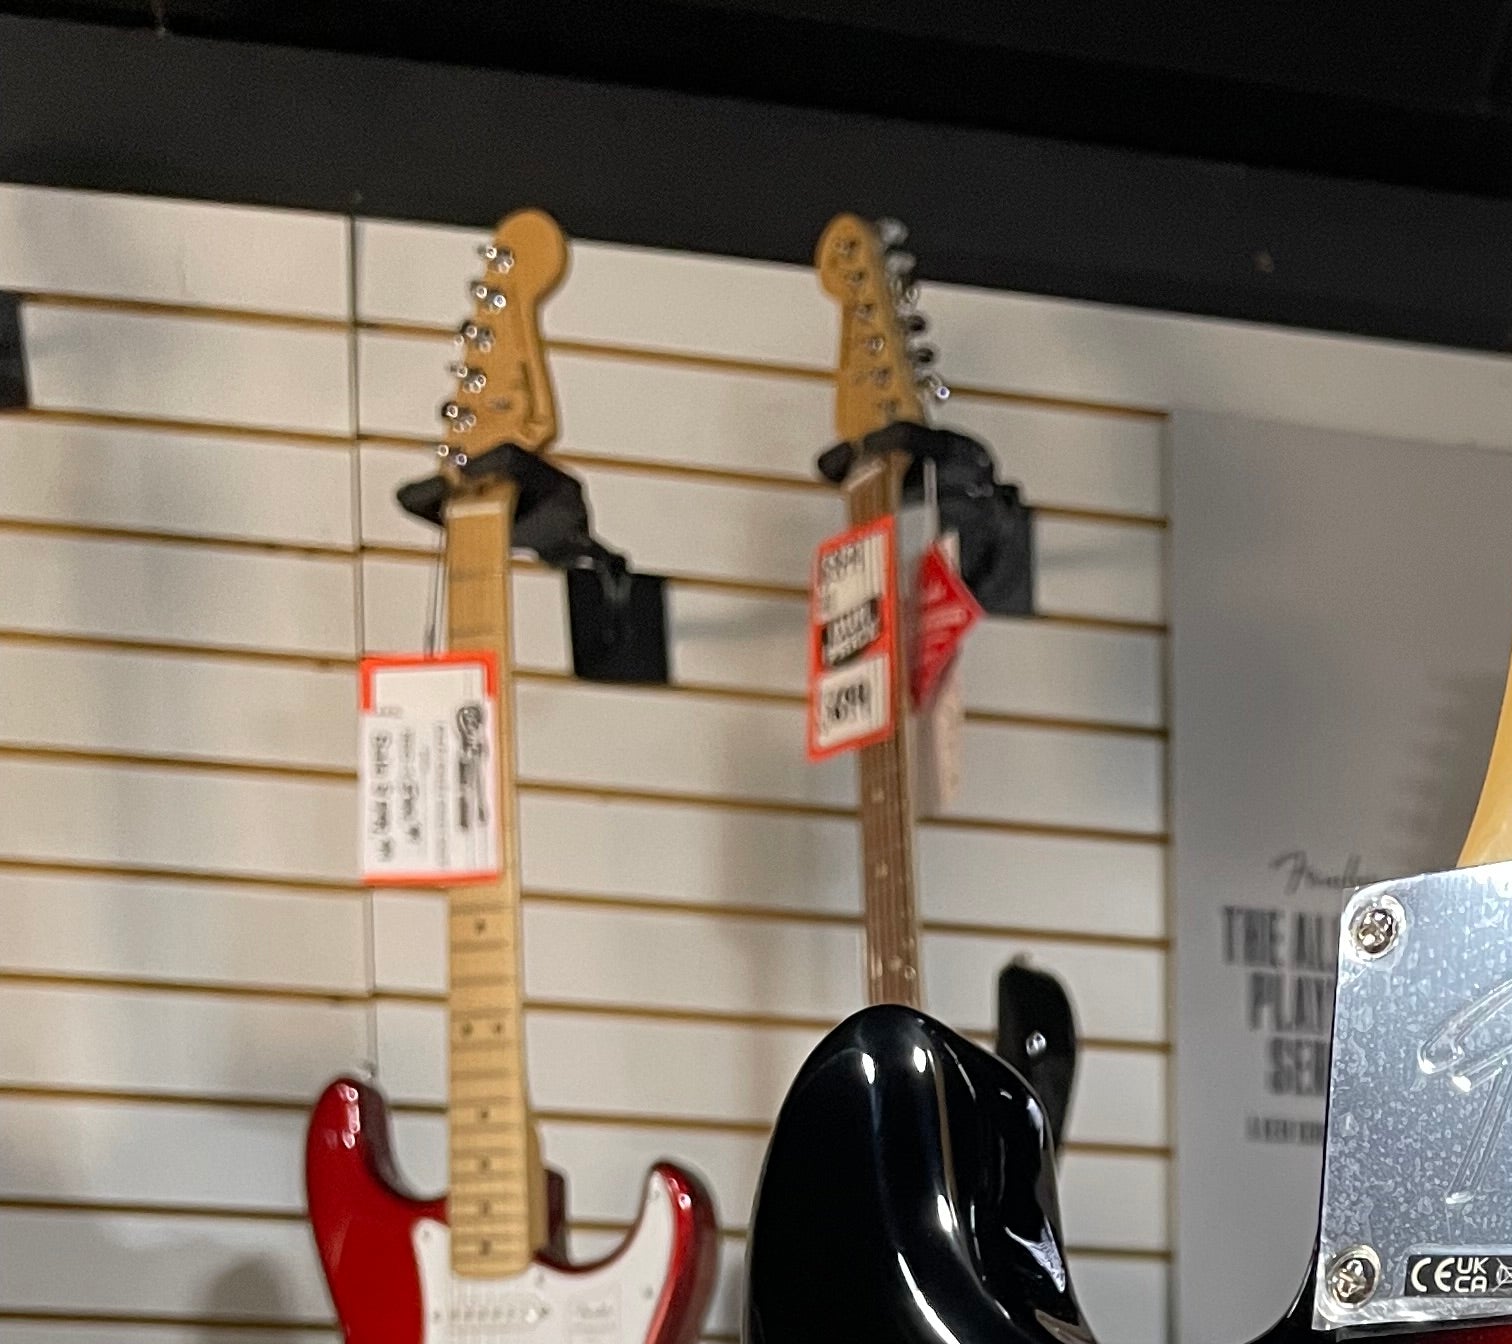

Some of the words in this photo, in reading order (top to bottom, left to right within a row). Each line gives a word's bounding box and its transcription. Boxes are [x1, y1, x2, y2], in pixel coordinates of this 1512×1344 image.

[1224, 907, 1281, 968] THE
[1411, 1257, 1455, 1293] CE
[1457, 1257, 1489, 1274] UK
[1454, 1275, 1487, 1293] CA
